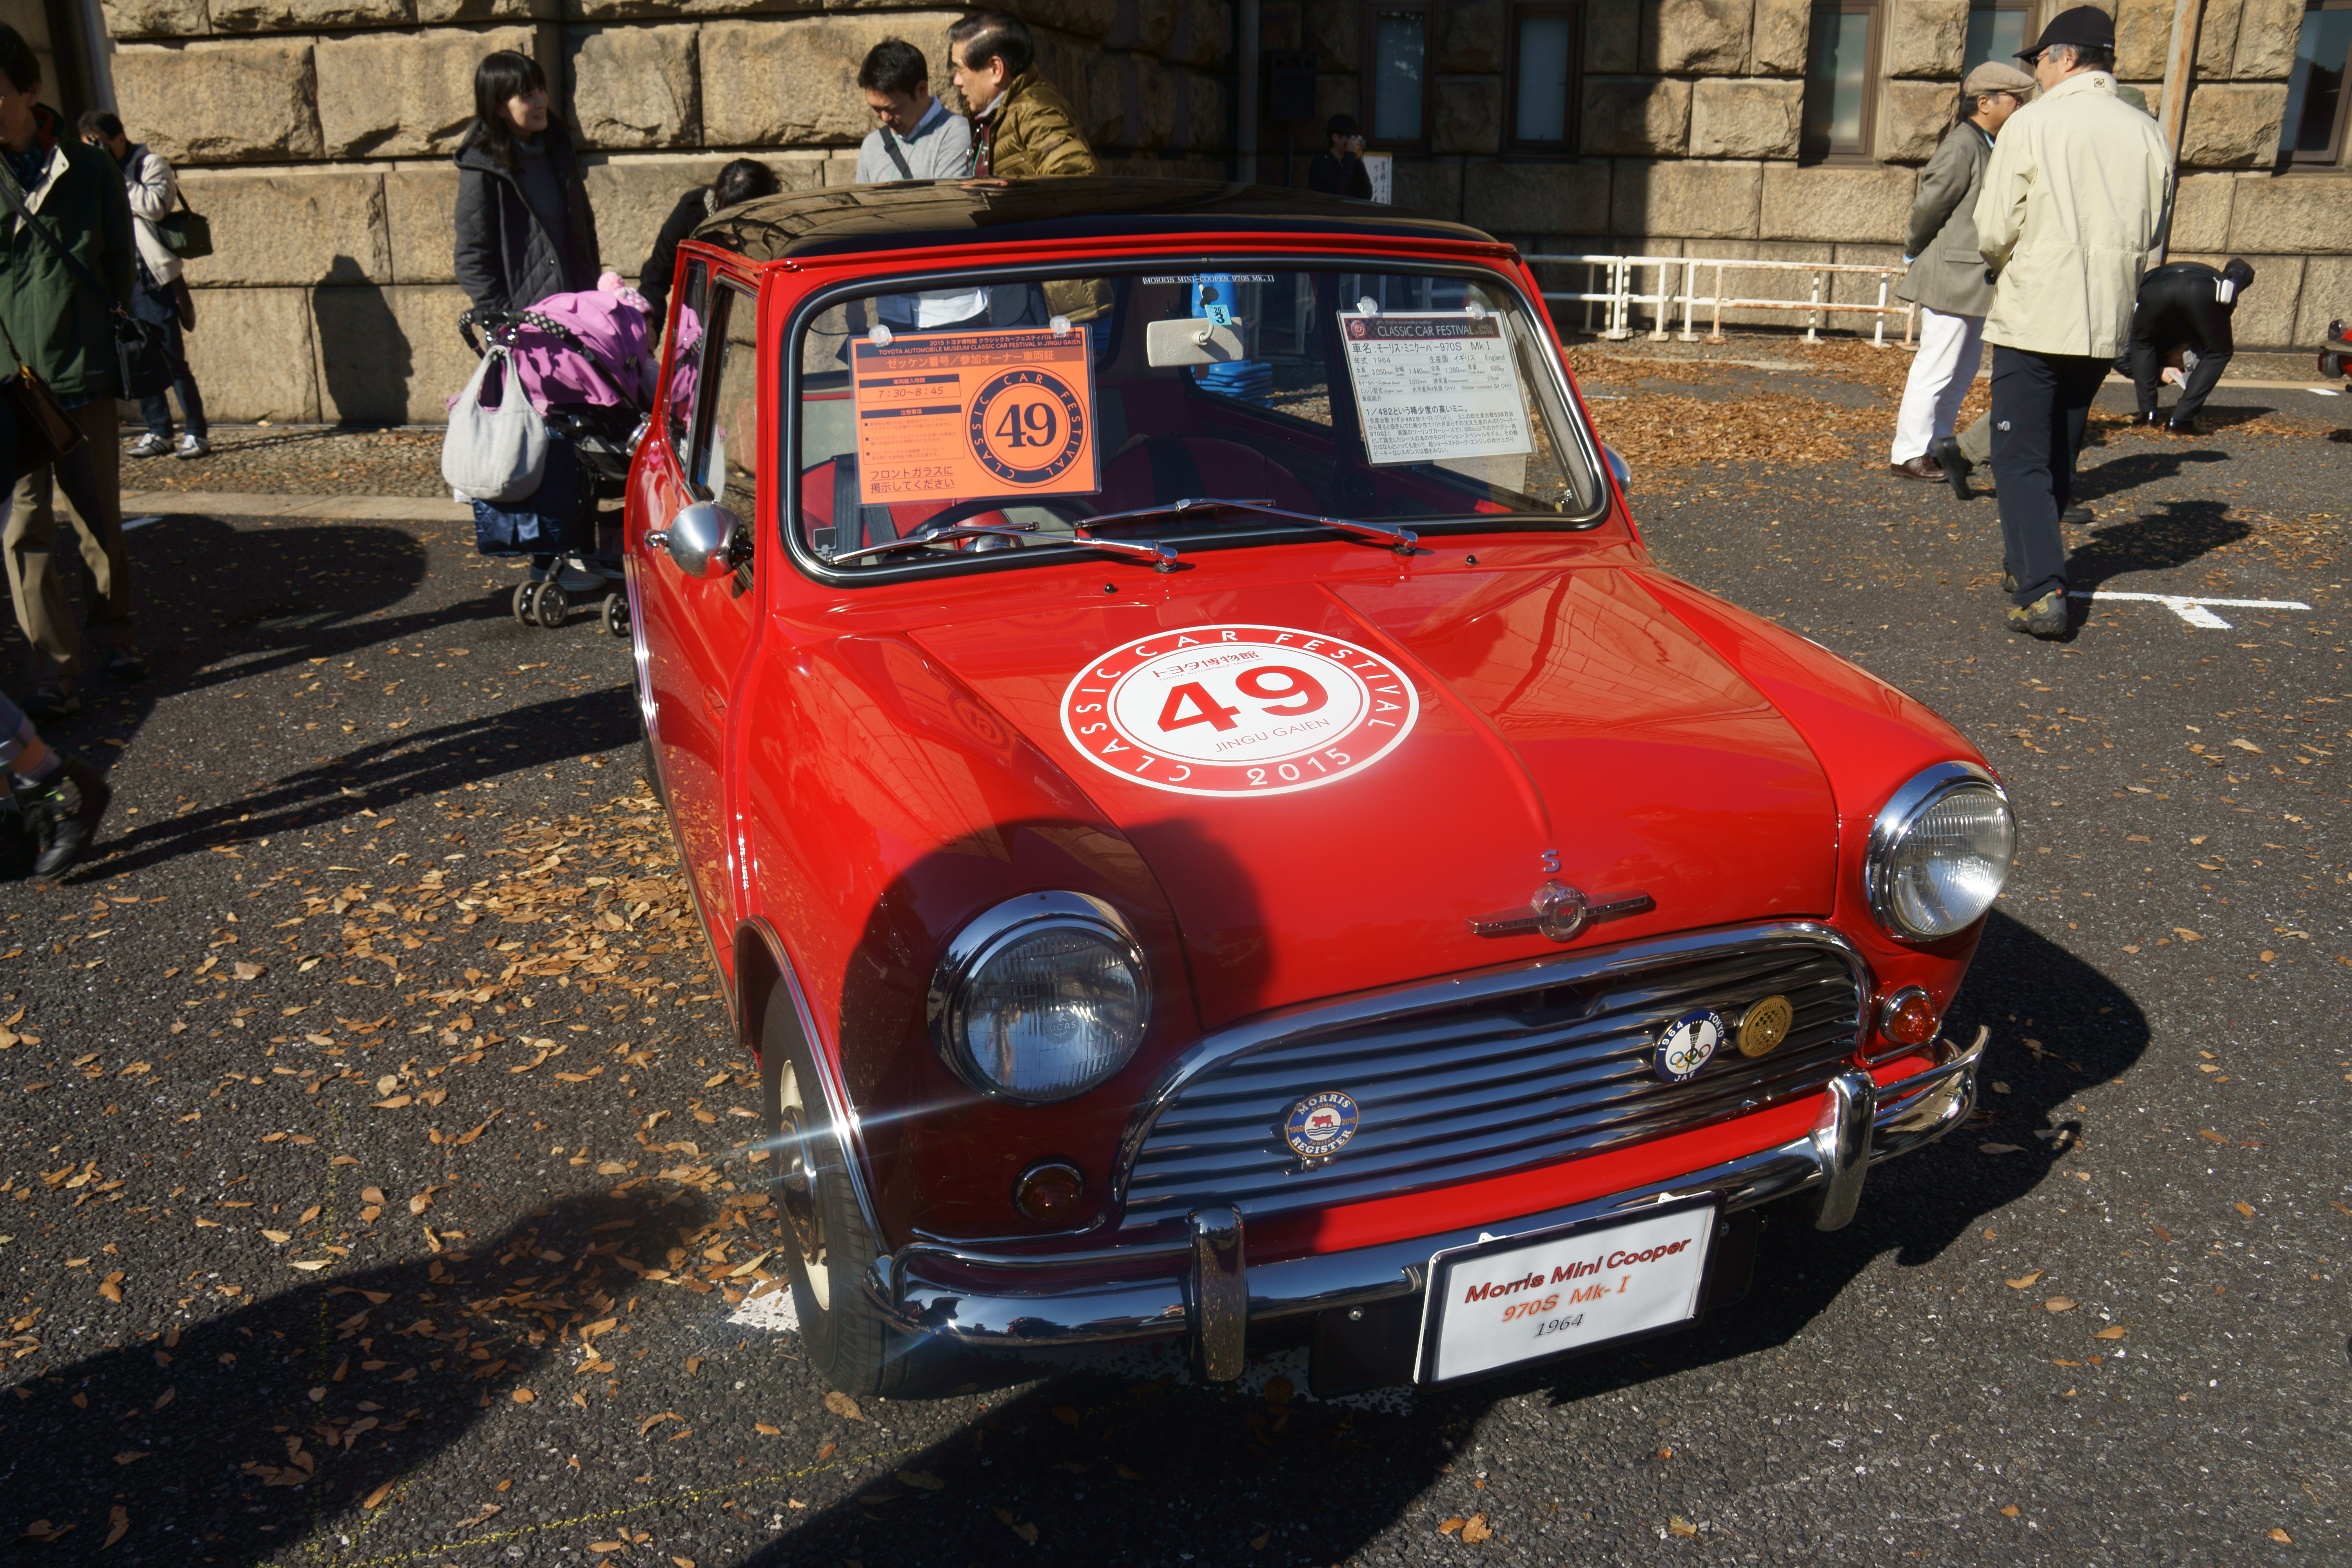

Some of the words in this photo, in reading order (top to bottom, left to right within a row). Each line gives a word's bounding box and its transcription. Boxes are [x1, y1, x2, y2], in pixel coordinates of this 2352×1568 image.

[1216, 313, 1225, 323] 3
[979, 334, 1051, 344] クラシックカーフェスティバル
[1377, 326, 1414, 337] CLASSIC
[1415, 326, 1434, 336] CAR
[1436, 325, 1474, 336] FESTIVAL
[1004, 372, 1043, 386] CAR
[995, 403, 1057, 448] 49
[1045, 391, 1081, 477] FESTIVAL
[973, 397, 1016, 479] CLASSIC
[870, 465, 953, 480] フロントガラスに
[871, 478, 955, 494] 掲示してください
[1135, 631, 1238, 657] CAR
[1152, 651, 1259, 678] トヨタ博物館
[1158, 673, 1185, 681] TOYOTA
[1188, 664, 1232, 675] AUTOMOBILE
[1233, 657, 1264, 666] MUSEUM
[1274, 633, 1402, 728] FESTIVAL
[1156, 665, 1329, 733] 49
[1076, 666, 1192, 782] CLASSIC
[1215, 731, 1269, 752] JINGU
[1272, 718, 1331, 737] GAIEN
[1246, 747, 1351, 786] 2015
[1541, 849, 1560, 873] S
[1762, 1000, 1780, 1012] mini
[1044, 1021, 1077, 1032] LUCAS
[1658, 1020, 1684, 1051] 1964
[1708, 1012, 1724, 1038] TOKYO
[1753, 1021, 1781, 1034] COOPER
[1747, 1039, 1777, 1054] register
[1674, 1071, 1695, 1082] JAF
[1297, 1094, 1351, 1115] MORRIS
[1311, 1103, 1337, 1112] Golden
[1289, 1125, 1305, 1133] 1960
[1341, 1117, 1356, 1125] 2010
[1291, 1129, 1352, 1154] REGISTER
[1307, 1137, 1336, 1146] Jubilee
[1464, 1272, 1545, 1303] Morris
[1550, 1256, 1604, 1284] Mini
[1607, 1238, 1691, 1269] Cooper
[1501, 1294, 1561, 1323] 970S
[1532, 1312, 1586, 1338] 1964
